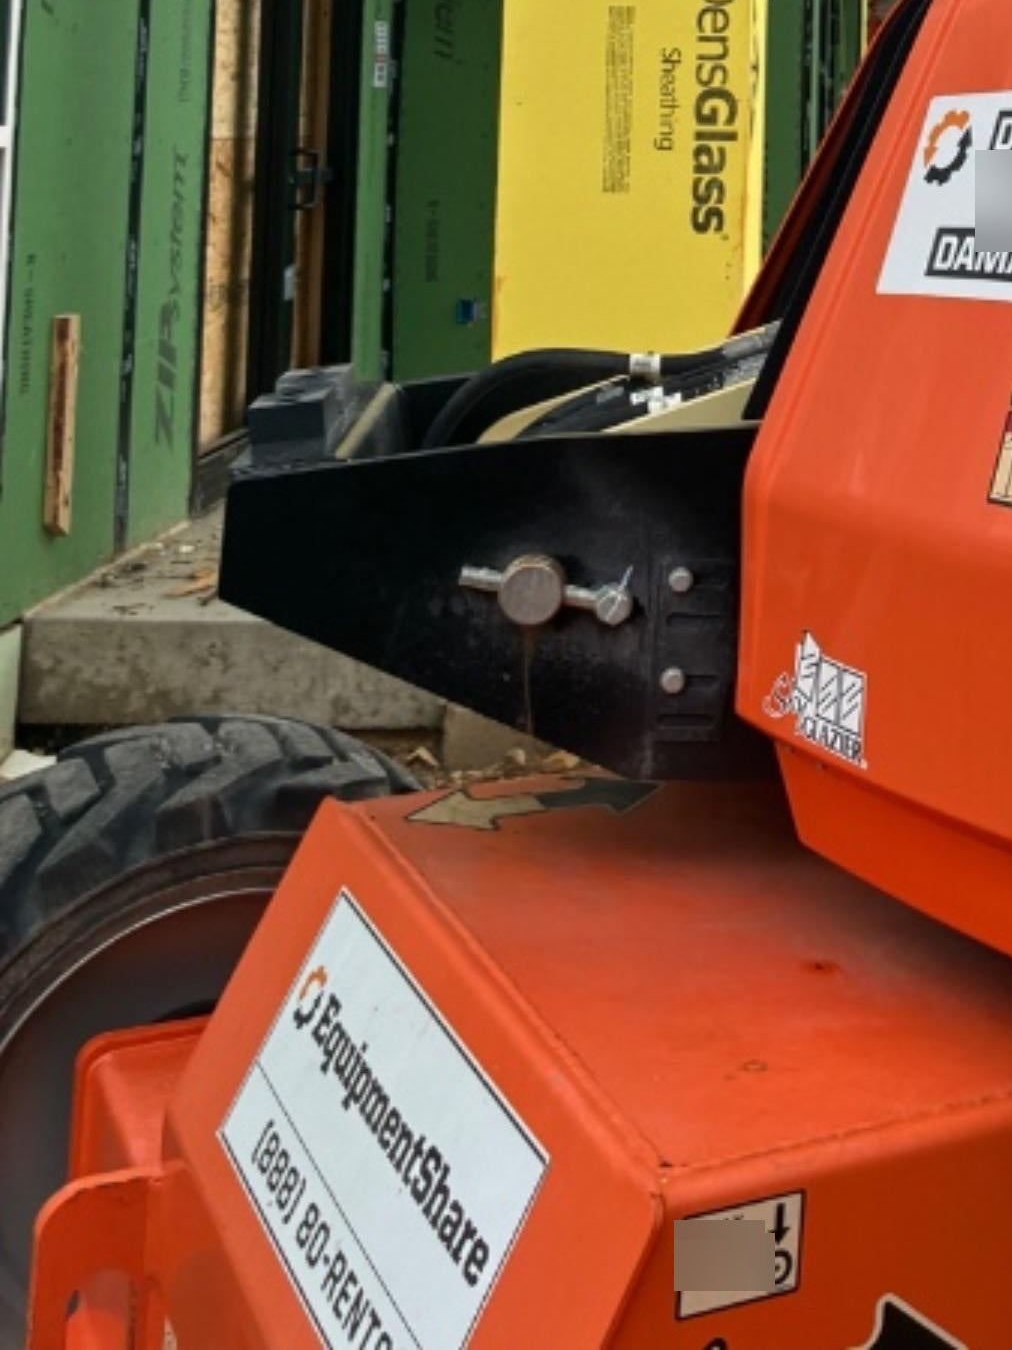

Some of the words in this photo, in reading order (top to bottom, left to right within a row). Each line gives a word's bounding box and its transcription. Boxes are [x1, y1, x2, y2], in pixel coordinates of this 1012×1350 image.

[653, 47, 682, 151] Sheathing
[250, 1118, 308, 1226] (888)
[311, 992, 490, 1288] EquipmentShare
